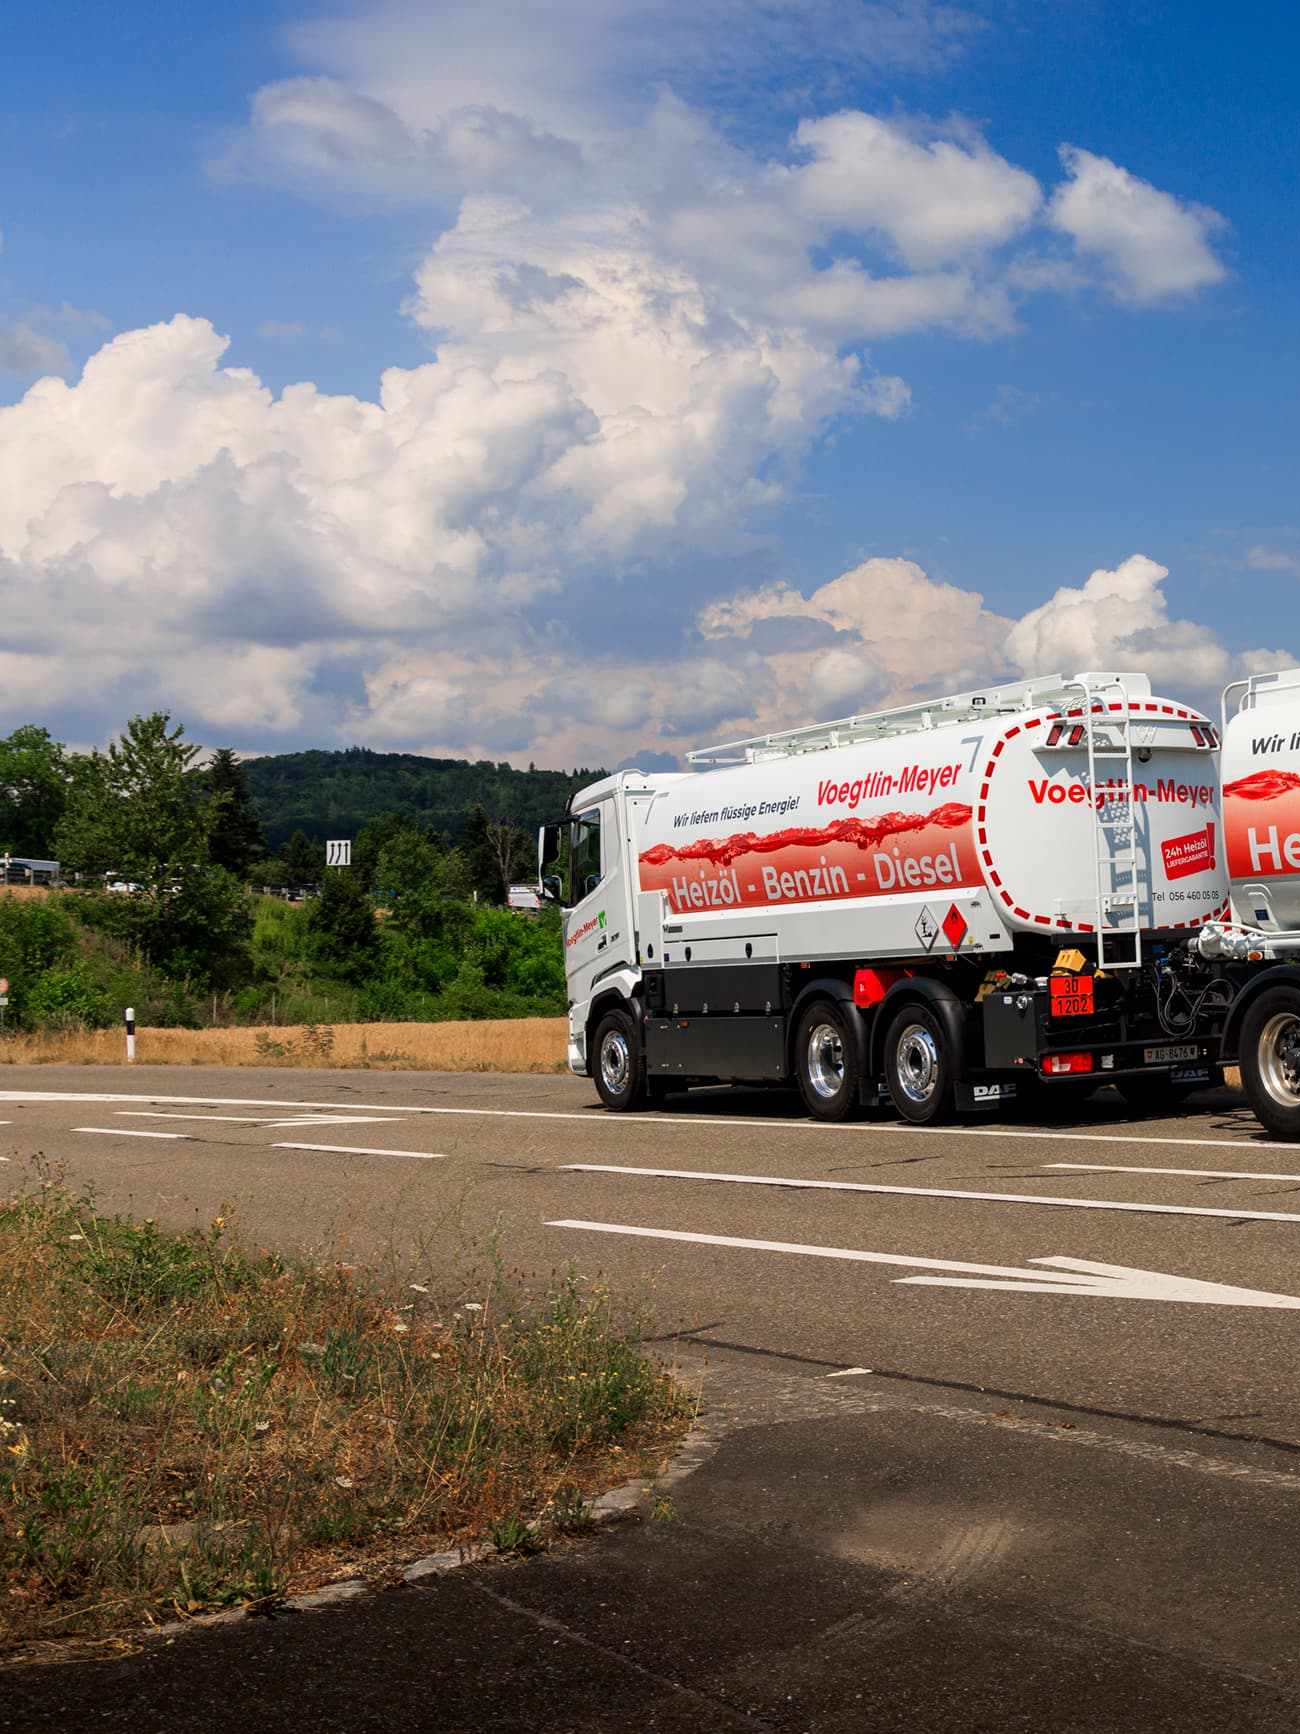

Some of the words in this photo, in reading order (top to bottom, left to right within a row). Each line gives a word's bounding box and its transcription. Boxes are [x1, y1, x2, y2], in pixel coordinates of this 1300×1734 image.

[1251, 733, 1285, 755] Wir
[817, 763, 962, 810] Voegtlin-Meyer
[673, 814, 690, 828] Wir
[690, 810, 719, 826] liefern
[720, 803, 757, 821] flüssige
[758, 796, 800, 815] Energie!
[1164, 845, 1182, 859] 24h
[1183, 837, 1208, 854] Heizöl
[672, 868, 742, 910] Heizöl
[762, 855, 849, 901] Benzin
[873, 842, 963, 890] Diesel
[1152, 891, 1165, 902] Tel
[1169, 891, 1185, 901] 056
[1186, 890, 1201, 901] 460
[1202, 890, 1211, 900] 05
[1212, 890, 1220, 900] 05
[1064, 978, 1078, 994] 30
[1057, 997, 1087, 1014] 1202
[973, 1084, 1016, 1097] DAF
